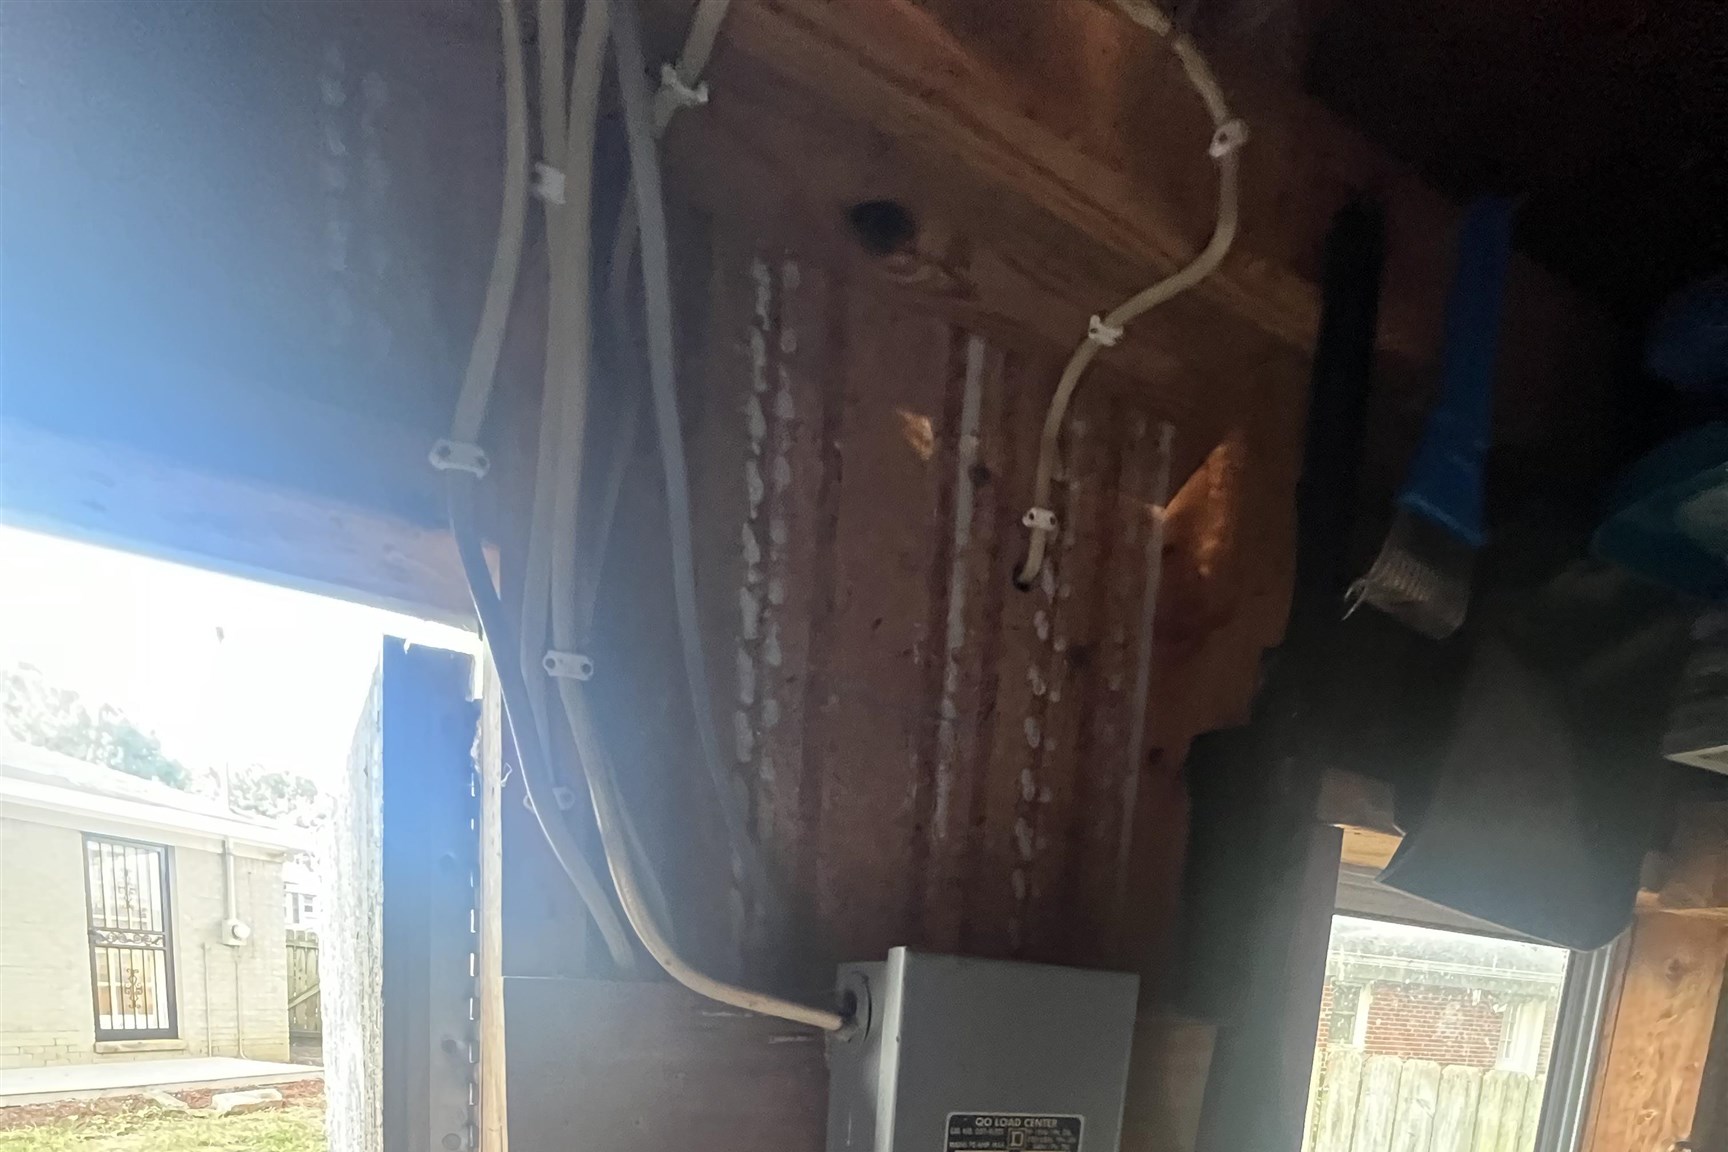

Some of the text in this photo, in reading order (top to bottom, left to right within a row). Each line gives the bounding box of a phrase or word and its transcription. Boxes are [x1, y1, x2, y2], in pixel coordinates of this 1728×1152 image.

[975, 1117, 1058, 1127] QO LOAD CENTER
